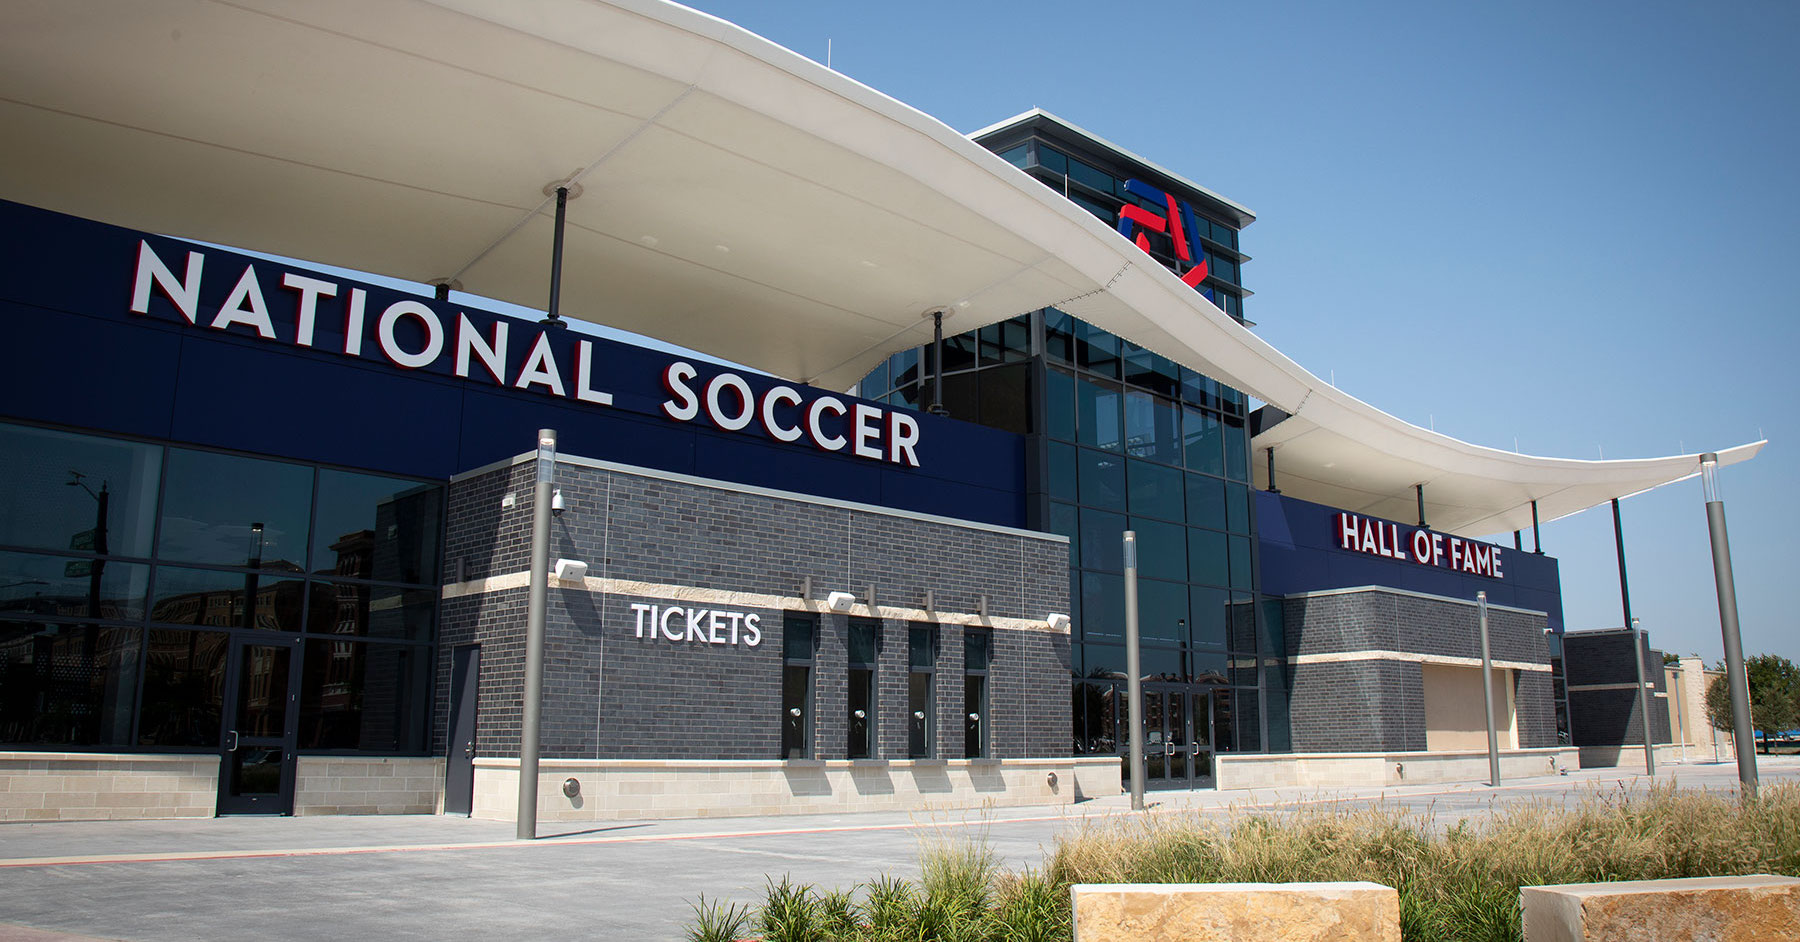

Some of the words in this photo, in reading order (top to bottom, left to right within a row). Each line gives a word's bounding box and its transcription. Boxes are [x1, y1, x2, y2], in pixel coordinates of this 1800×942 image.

[130, 239, 613, 407] NATIONAL
[661, 361, 921, 467] SOCCER
[1337, 512, 1406, 559] HALL
[1410, 530, 1443, 566] OF
[1447, 537, 1504, 578] FAME
[631, 604, 762, 647] TICKETS
